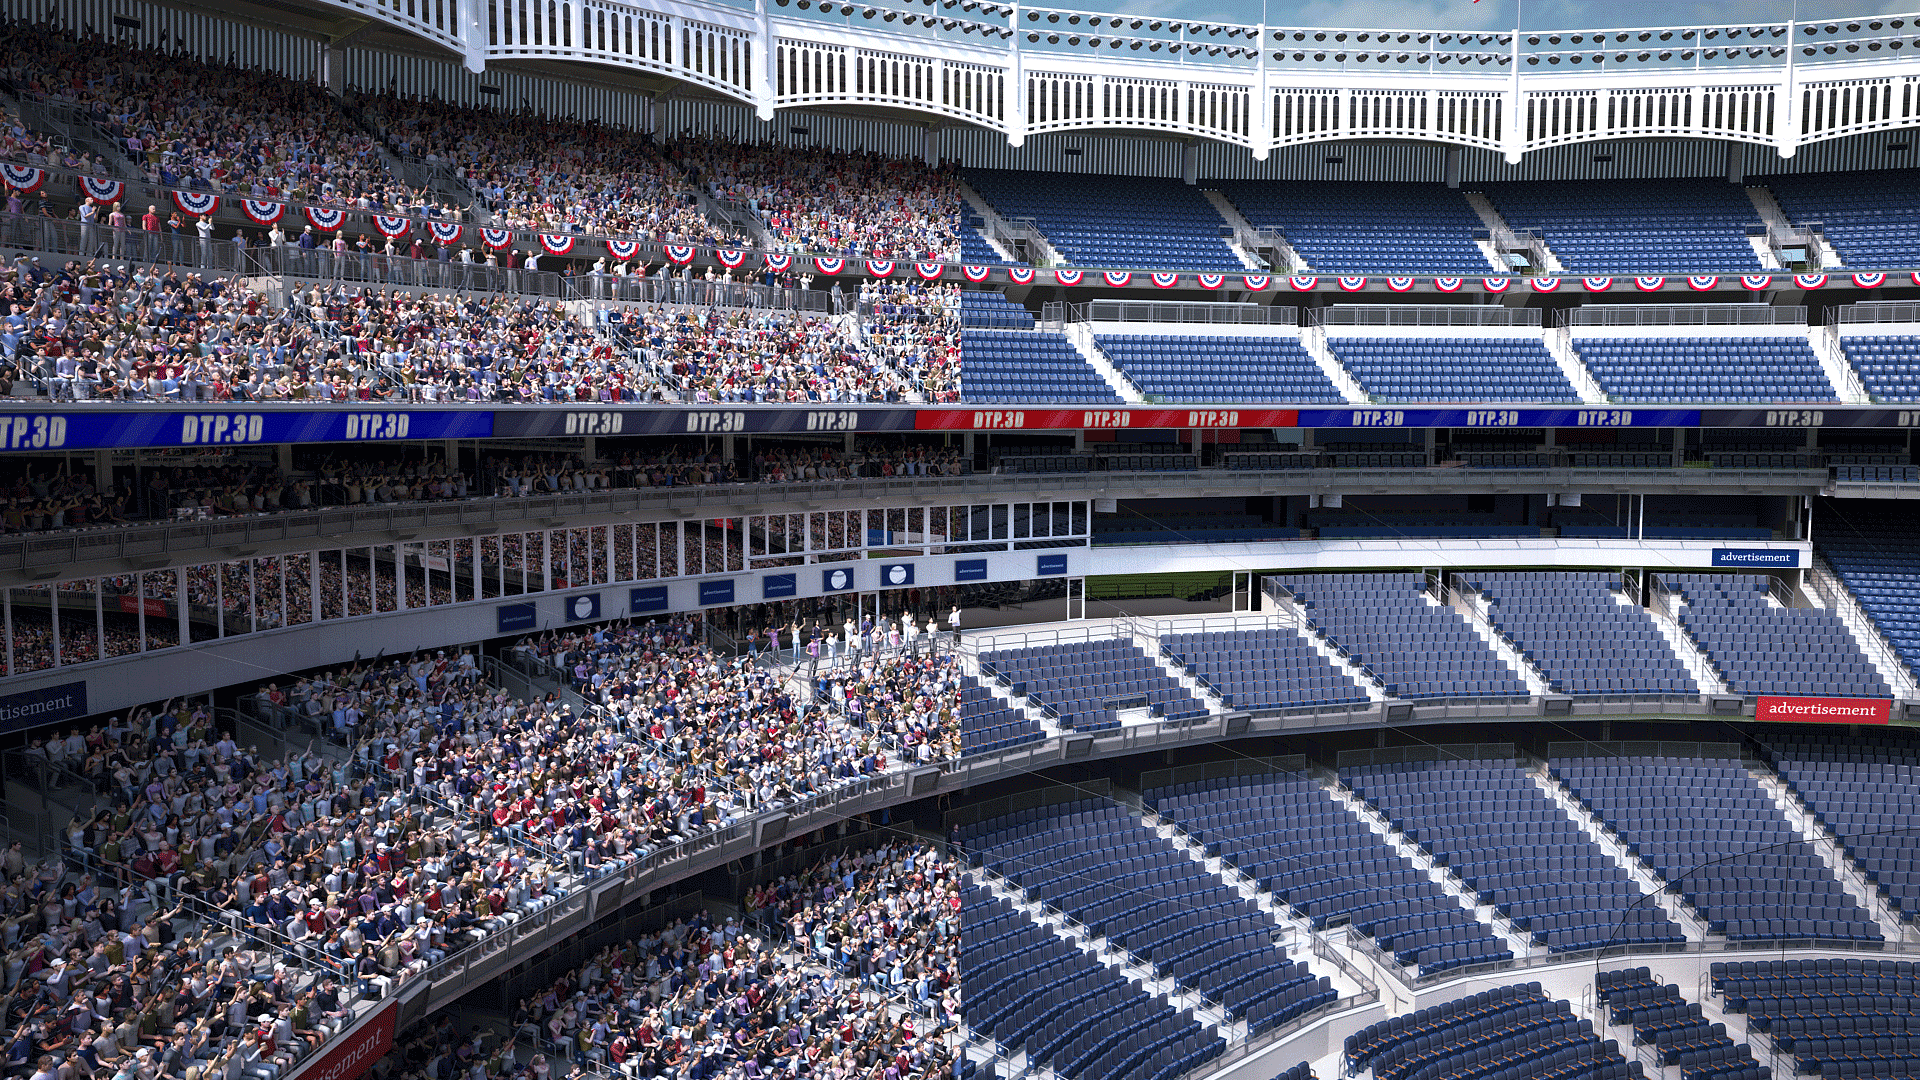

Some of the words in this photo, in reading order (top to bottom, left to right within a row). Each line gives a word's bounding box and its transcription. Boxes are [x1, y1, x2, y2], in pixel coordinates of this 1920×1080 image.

[346, 414, 409, 438] DTP.3D
[565, 412, 623, 434] DTP.3D
[687, 412, 745, 432] DTP.3D
[807, 412, 858, 430] DTP.3D
[973, 411, 1025, 428] DTP.3D
[1083, 411, 1131, 427] DTP.3D
[1188, 411, 1239, 427] DTP.3D
[1352, 411, 1404, 426] DTP.3D
[1467, 411, 1519, 426] DTP.3D
[1577, 411, 1632, 426] DTP.3D
[1766, 411, 1824, 426] DTP.3D
[182, 414, 263, 443] DTP.3D
[1720, 552, 1791, 562] advertisement
[1768, 701, 1877, 717] advertisement
